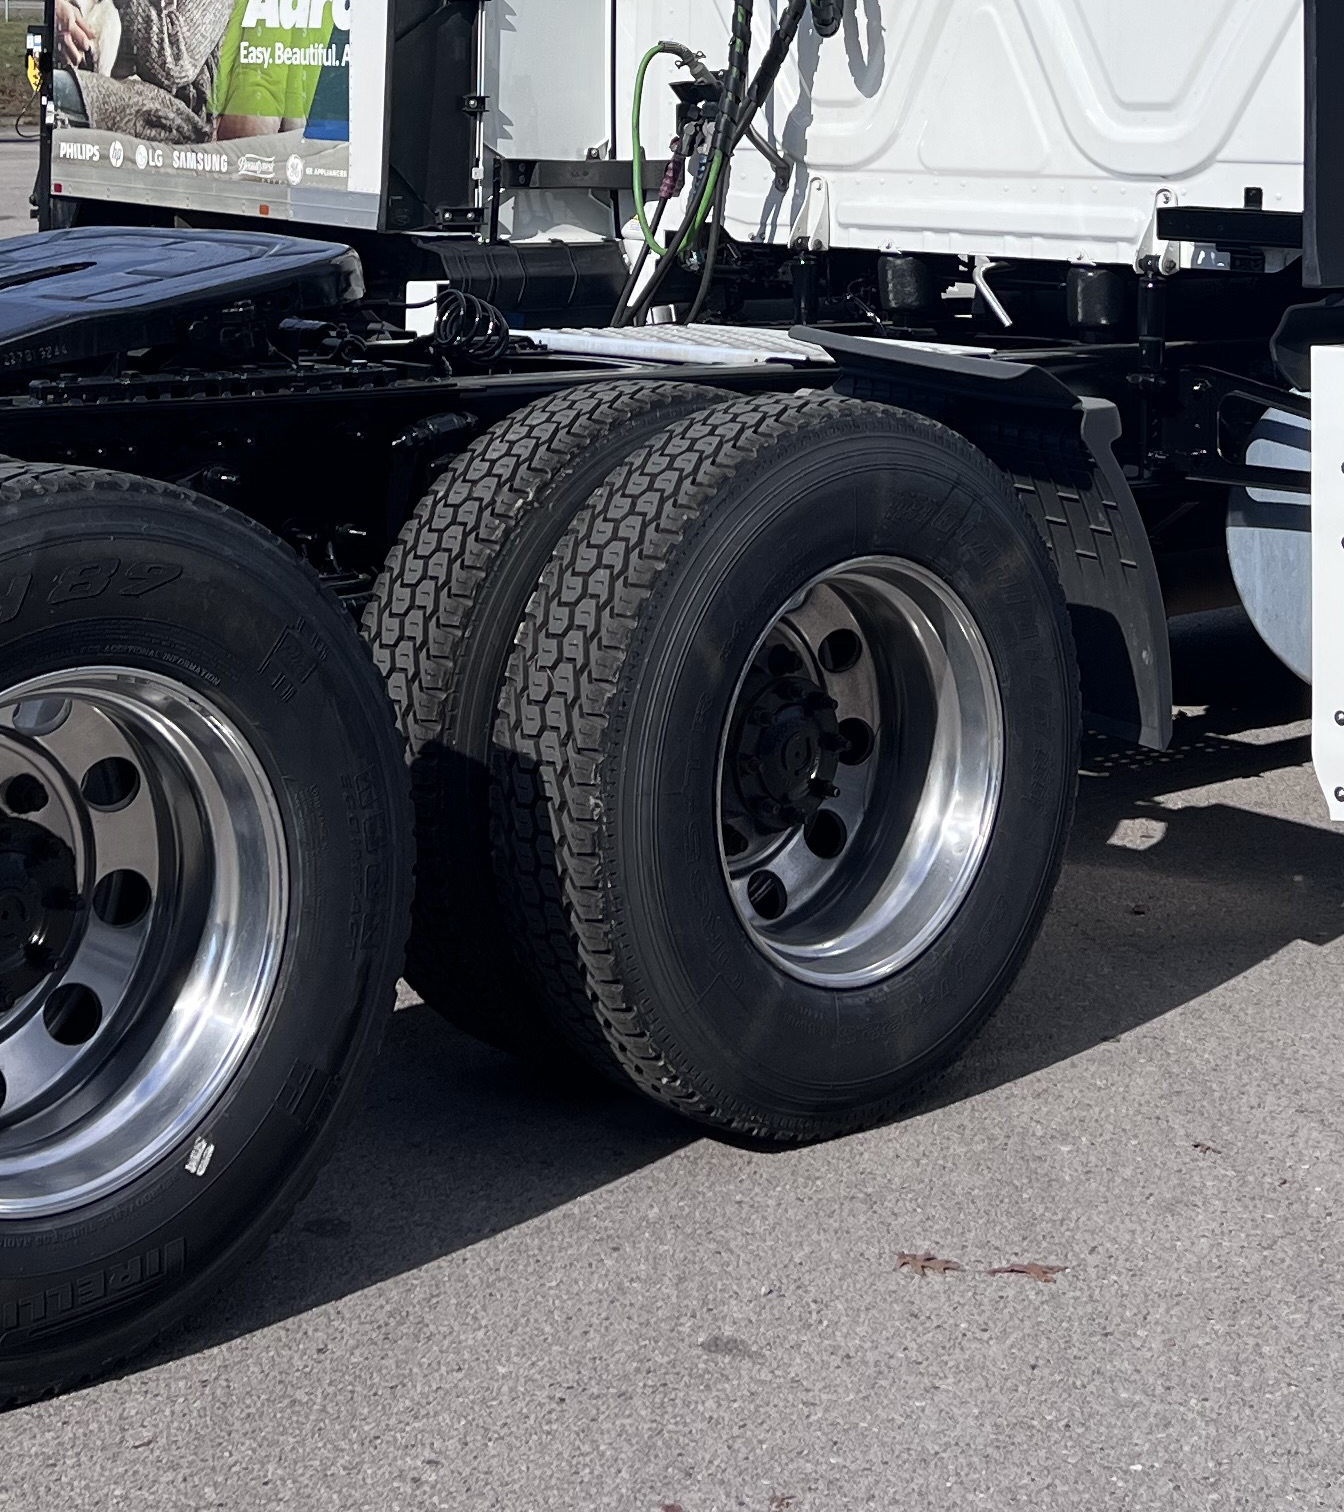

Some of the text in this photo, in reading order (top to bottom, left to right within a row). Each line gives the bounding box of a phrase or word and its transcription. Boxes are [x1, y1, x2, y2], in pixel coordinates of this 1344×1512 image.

[240, 42, 273, 68] Easy.
[275, 42, 339, 66] Beautiful.
[59, 142, 100, 162] PHILIPS
[149, 149, 163, 167] LG
[172, 150, 228, 172] SAMSUNG
[48, 560, 184, 603] 89
[162, 652, 221, 687] INFORMATION
